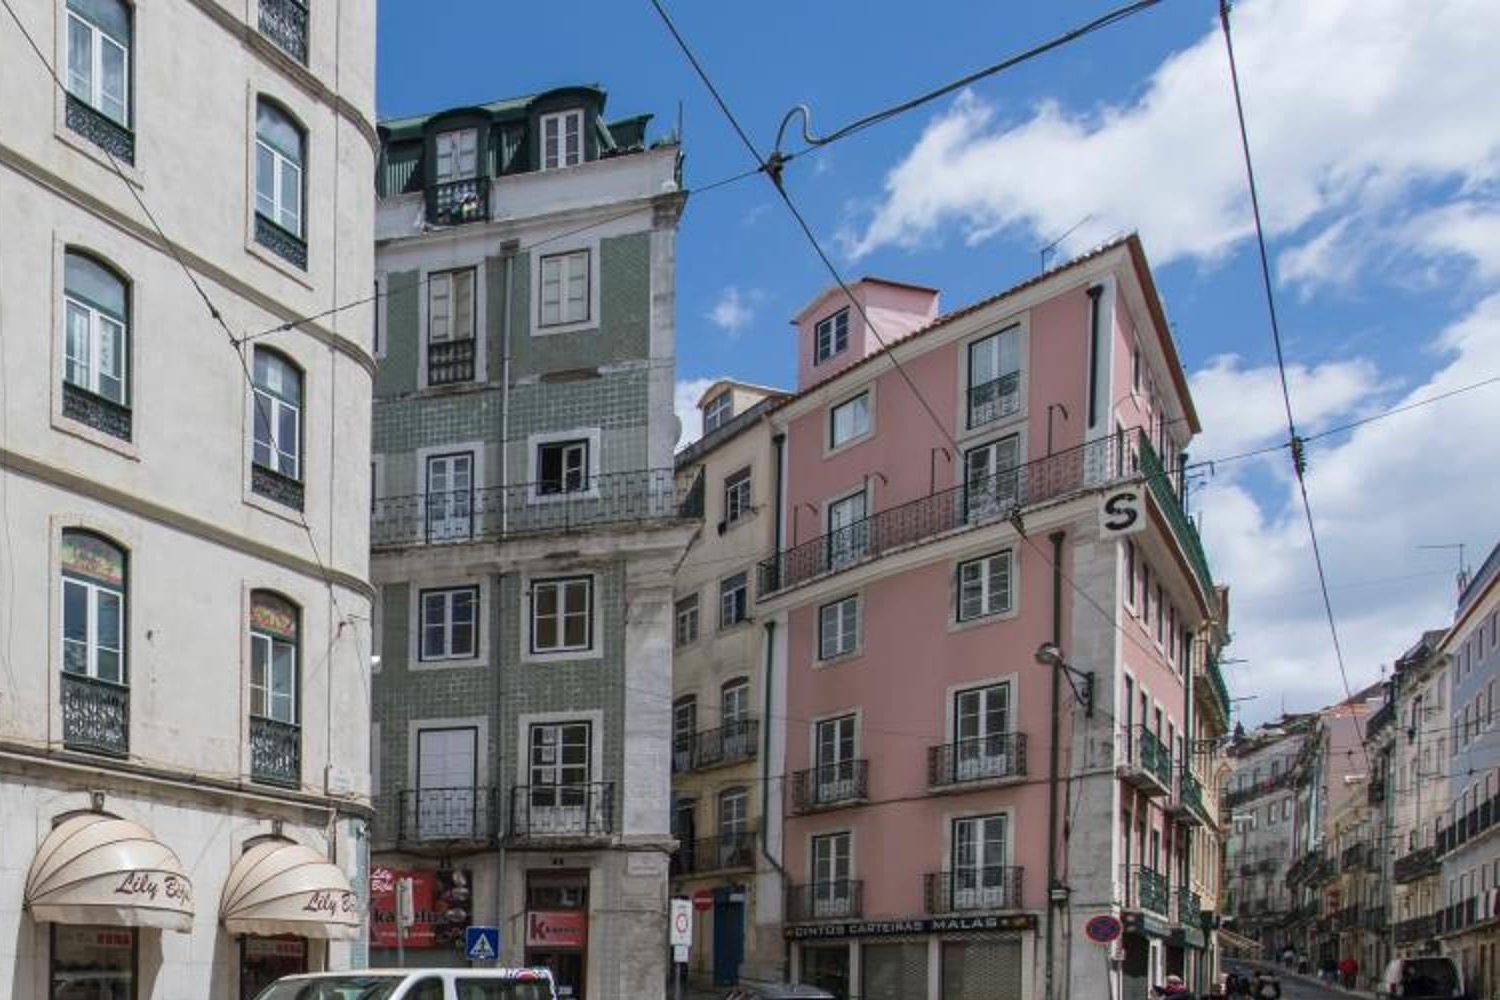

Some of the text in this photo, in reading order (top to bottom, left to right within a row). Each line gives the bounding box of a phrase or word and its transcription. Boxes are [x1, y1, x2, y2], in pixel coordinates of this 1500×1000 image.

[1105, 493, 1137, 531] S
[115, 871, 159, 901] Lily
[303, 890, 337, 916] Lily
[795, 917, 997, 937] CINTOS CARTEIRAS MALAS
